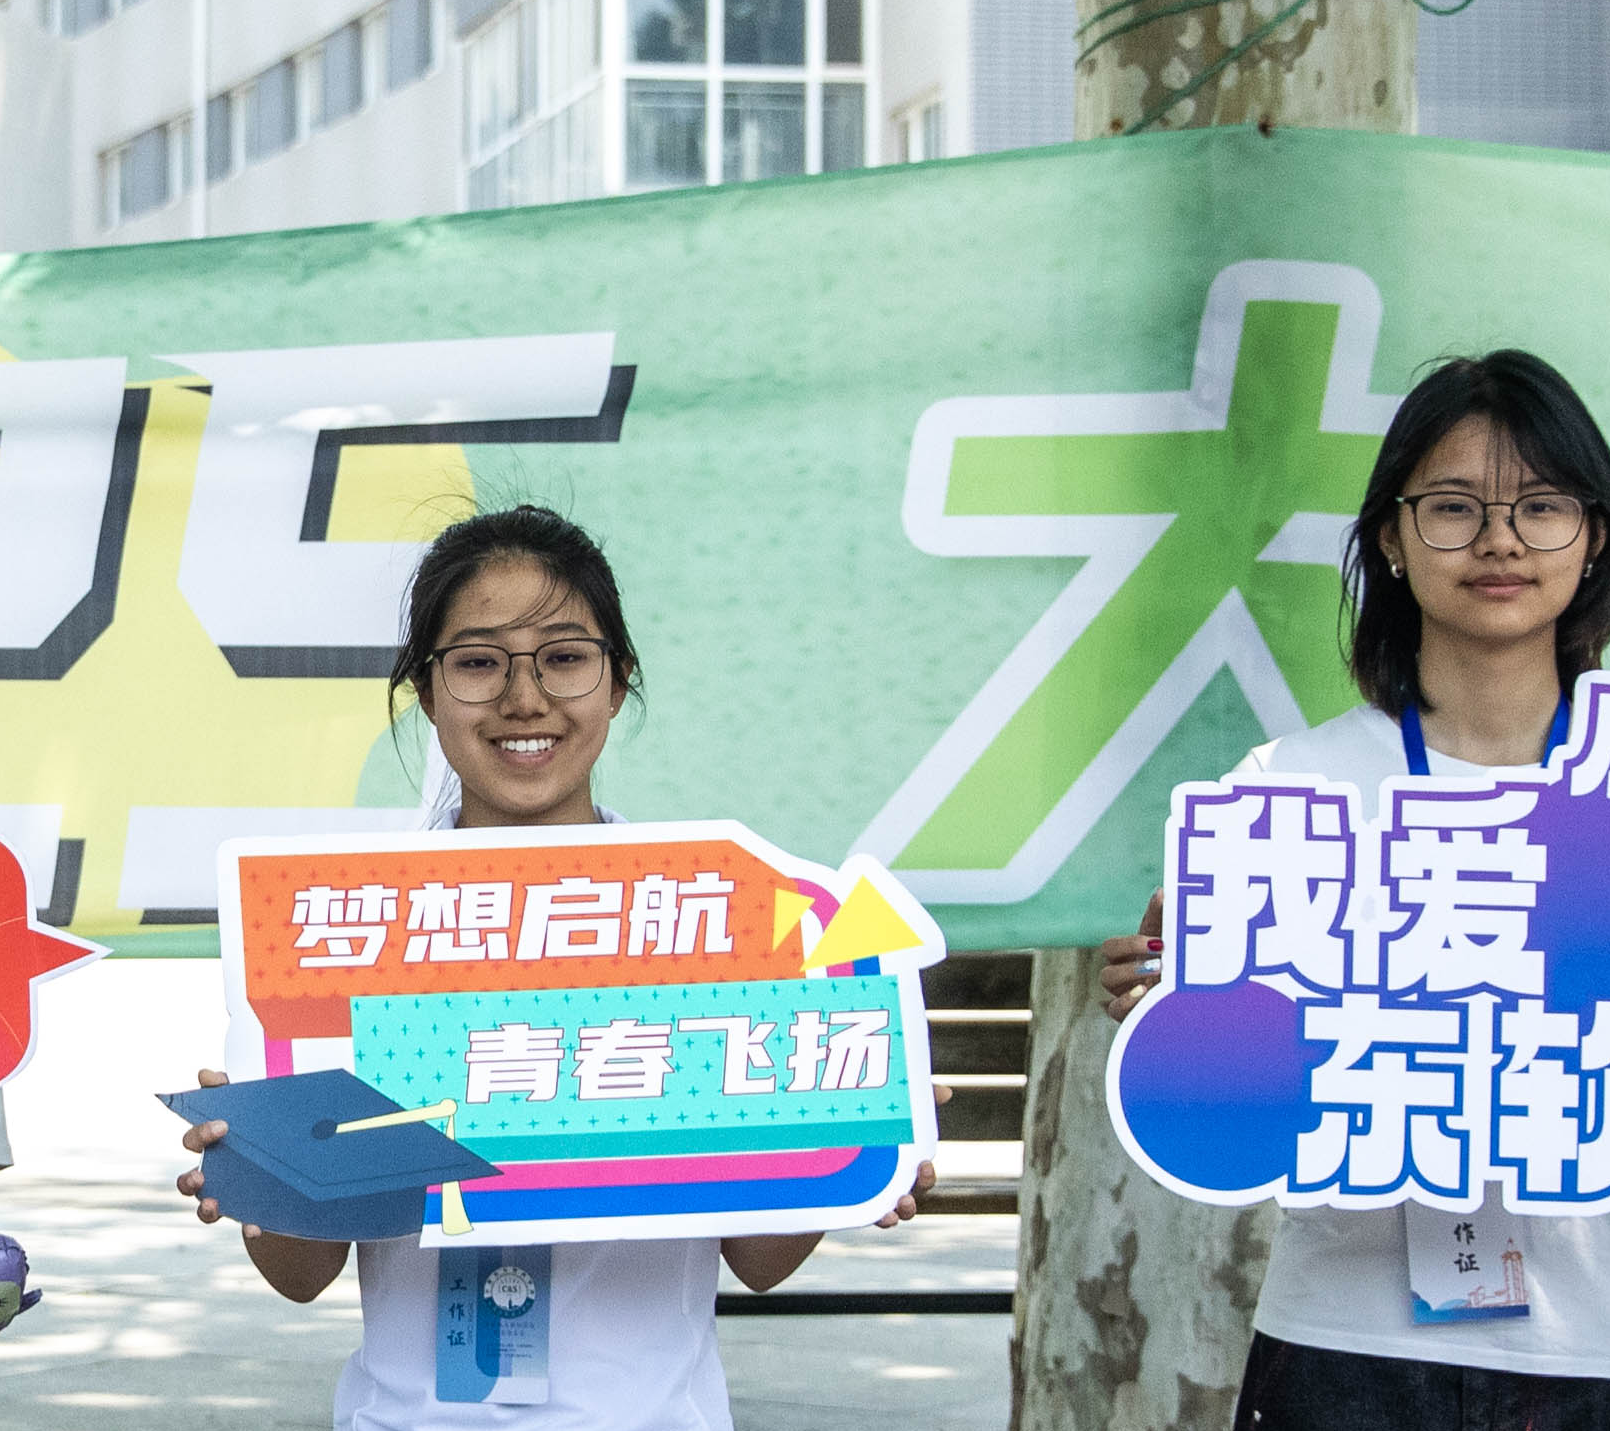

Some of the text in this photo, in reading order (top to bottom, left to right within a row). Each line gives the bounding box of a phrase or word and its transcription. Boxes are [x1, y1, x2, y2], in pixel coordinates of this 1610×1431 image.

[291, 872, 736, 969] 梦想启航
[1186, 790, 1547, 995] 我爱
[464, 1009, 891, 1104] 青春飞扬
[447, 1278, 467, 1346] 工作证
